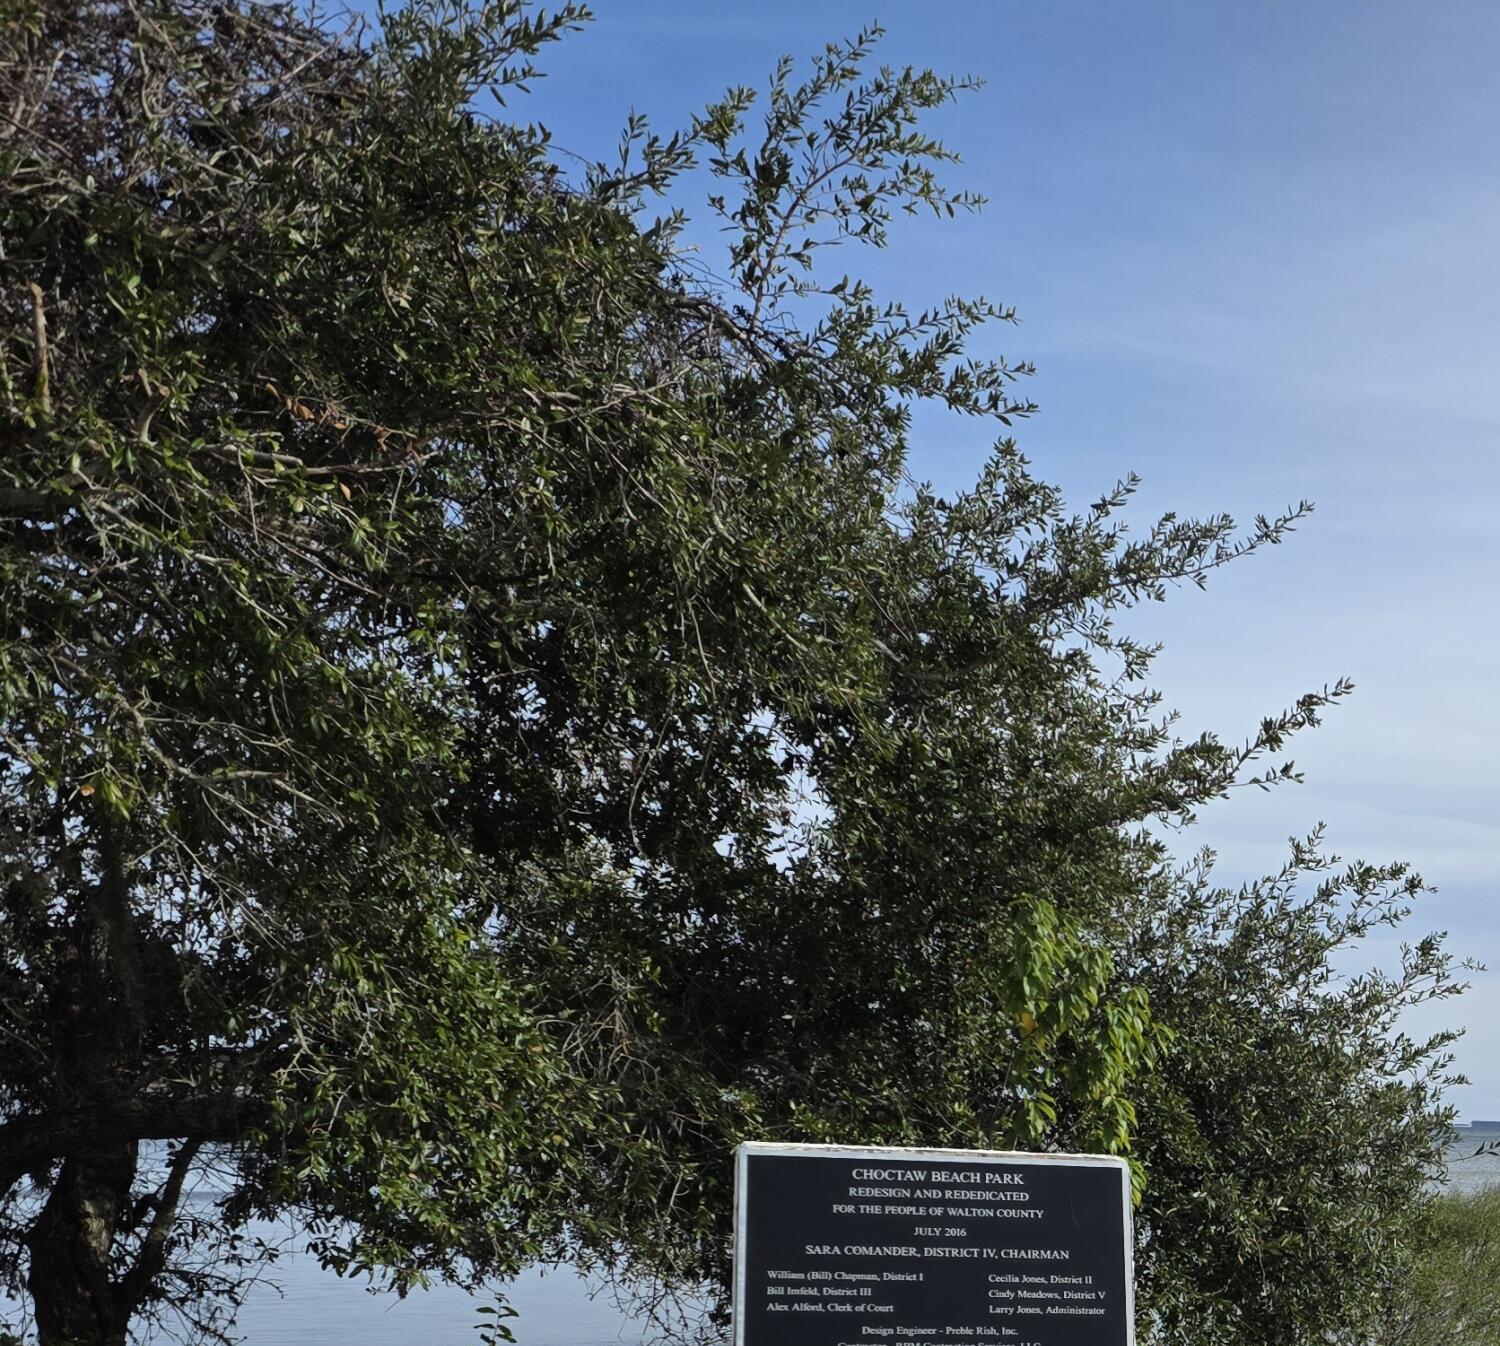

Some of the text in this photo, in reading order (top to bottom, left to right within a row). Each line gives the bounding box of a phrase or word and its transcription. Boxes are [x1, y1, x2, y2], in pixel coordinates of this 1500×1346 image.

[852, 1169, 1024, 1184] CHOCTAW BEACH PARK
[849, 1188, 1028, 1201] REDESIGN AND REDEDICATED
[833, 1205, 1043, 1218] FOR THE PEOPLE OF WALTON COUNTY
[914, 1227, 966, 1236] JULY 2016
[806, 1245, 1069, 1260] SARA COMANDER, DISTRICT IV, CHAIRMAN
[767, 1271, 923, 1281] William (Bill) Chapman, District I
[989, 1274, 1092, 1284] Cecilia Jones, District II
[787, 1288, 820, 1296] Imfeld,
[823, 1288, 857, 1296] District
[989, 1290, 1014, 1300] Cindy
[1018, 1291, 1061, 1299] Meadows,
[1064, 1291, 1095, 1299] District
[767, 1303, 893, 1312] Alex Alford, Clerk of Court
[989, 1306, 1106, 1315] Larry Jones, Administrator
[862, 1327, 893, 1335] Design
[897, 1327, 936, 1336] Engineer
[946, 1327, 973, 1335] Preble
[977, 1327, 999, 1336] Rish,
